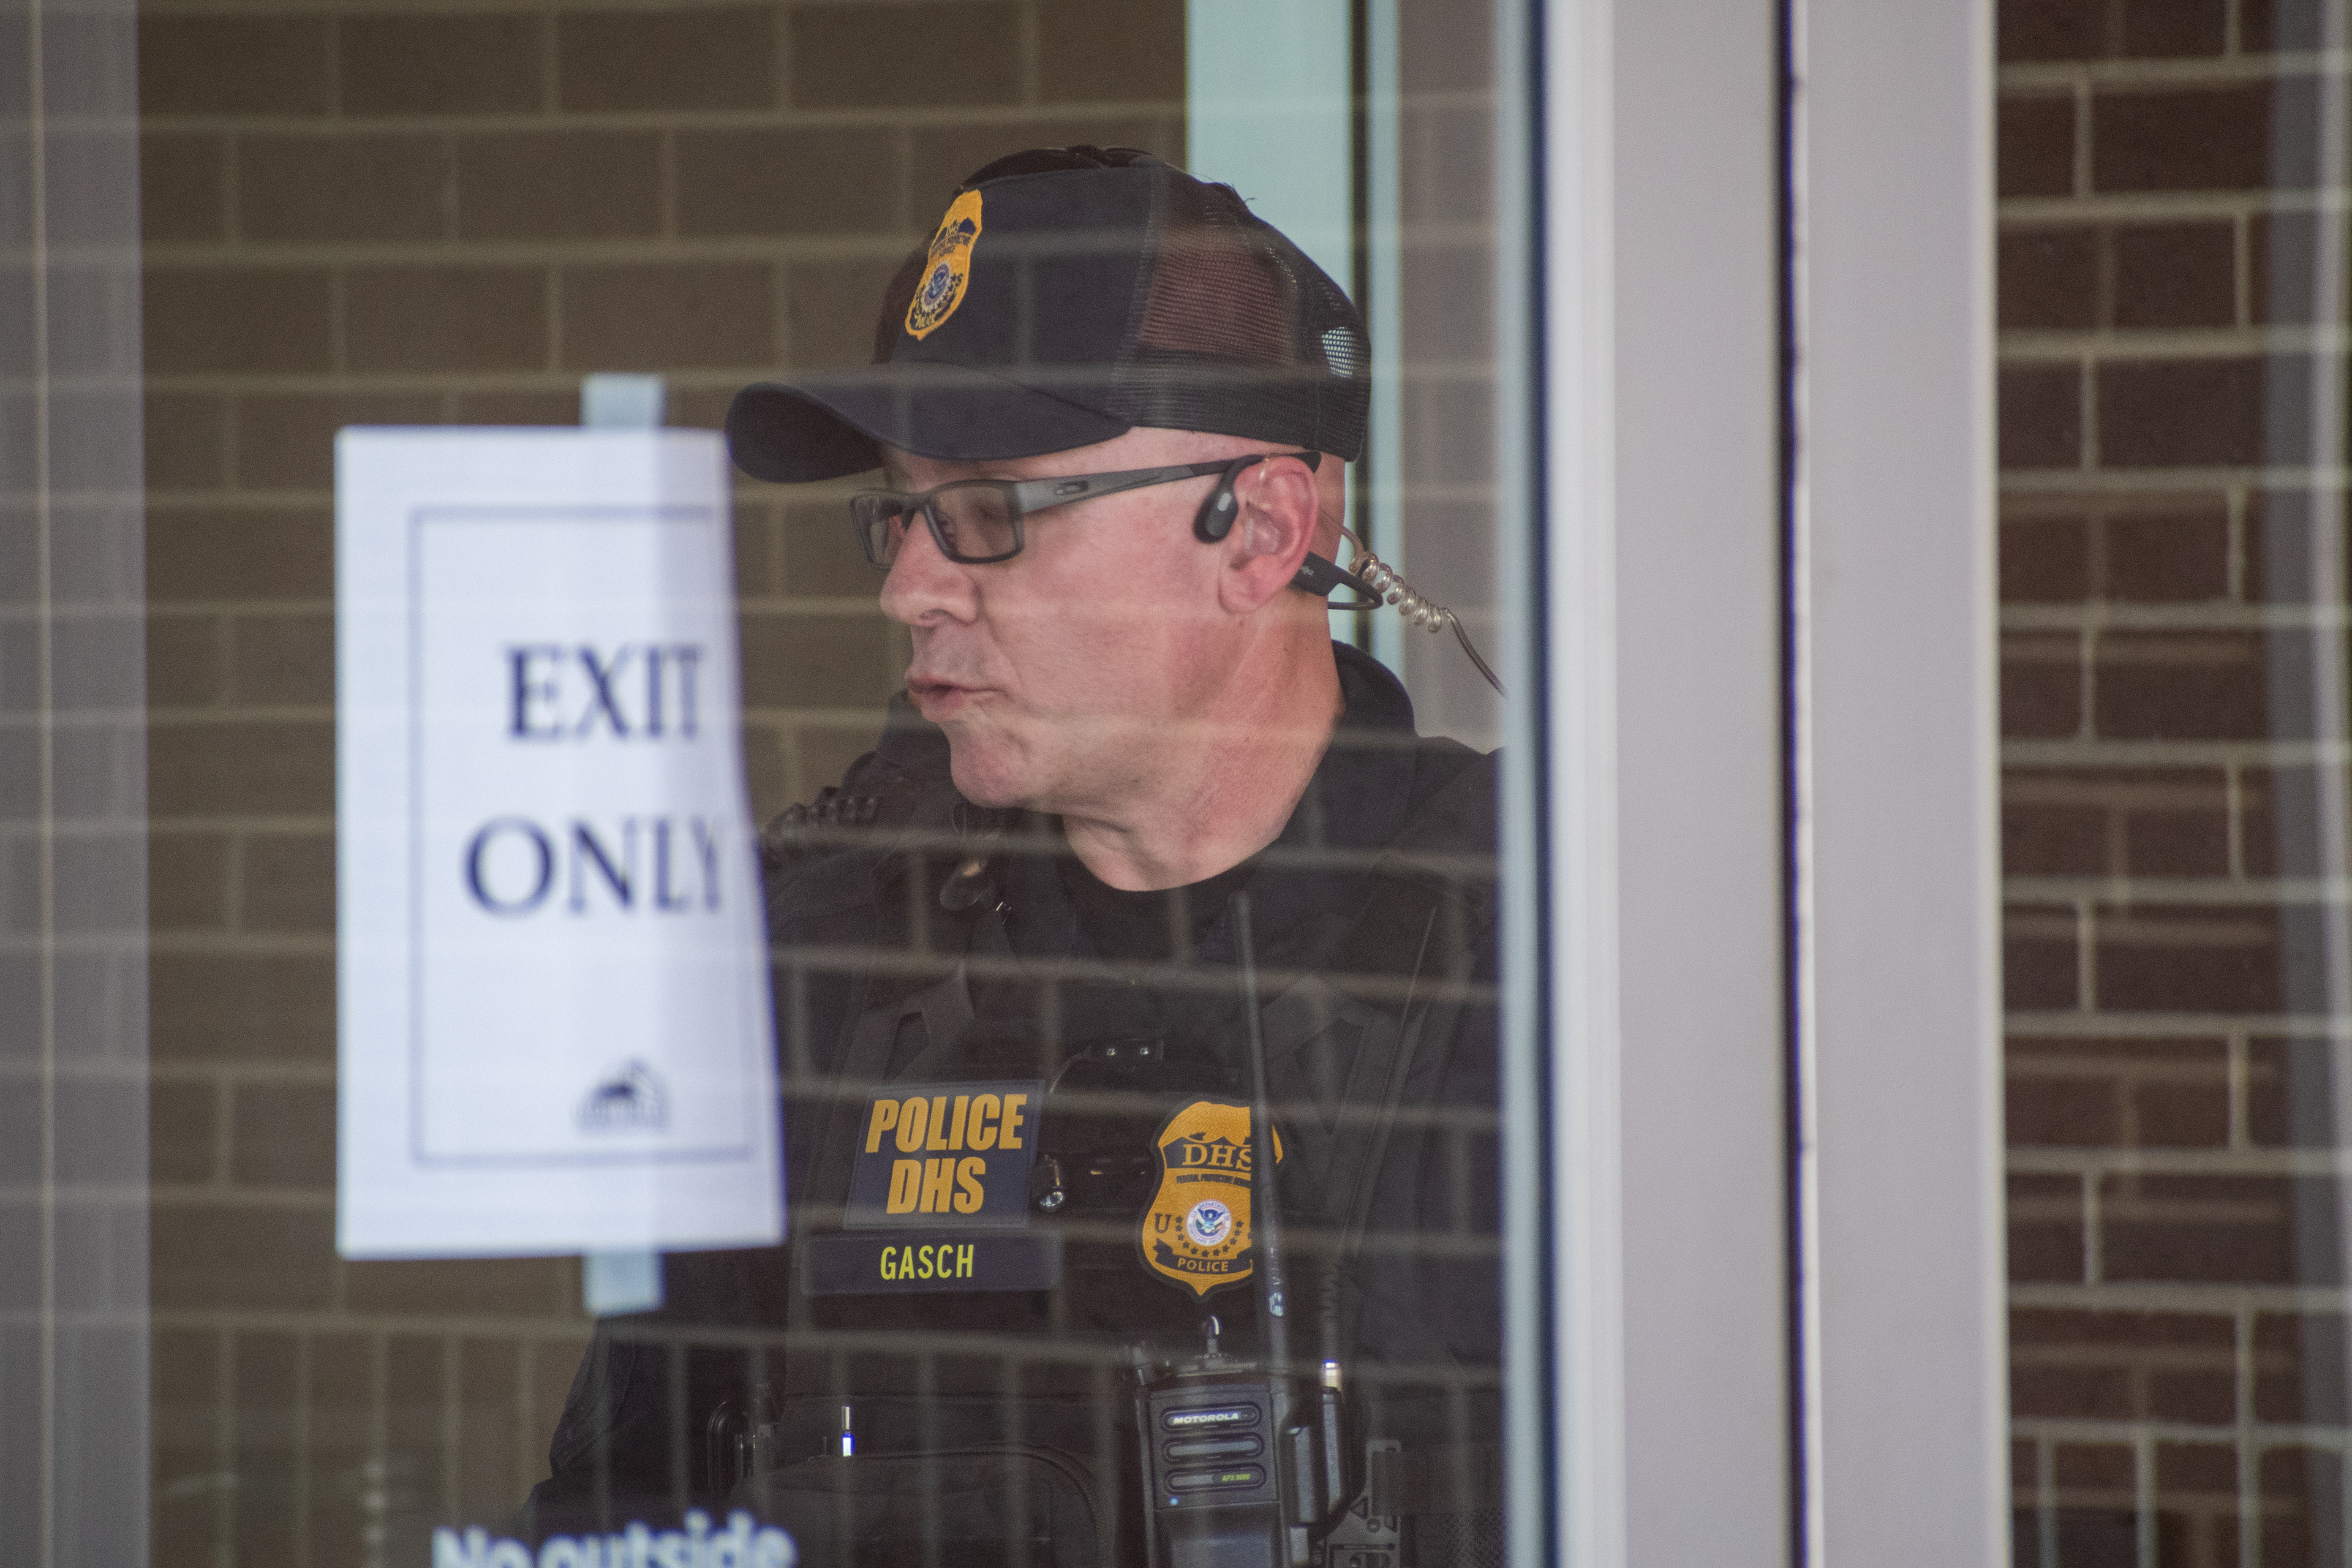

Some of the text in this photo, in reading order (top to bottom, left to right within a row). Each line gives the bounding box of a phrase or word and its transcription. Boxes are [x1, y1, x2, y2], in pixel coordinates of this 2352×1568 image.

[507, 645, 703, 740] EXIT
[464, 818, 726, 919] ONLY
[865, 1093, 1027, 1153] POLICE
[1182, 1144, 1251, 1171] DHS
[886, 1156, 986, 1214] DHS
[1155, 1213, 1172, 1234] U
[880, 1244, 974, 1280] GASCH
[1177, 1257, 1229, 1272] POLICE
[1174, 1412, 1238, 1425] MOTOROLA
